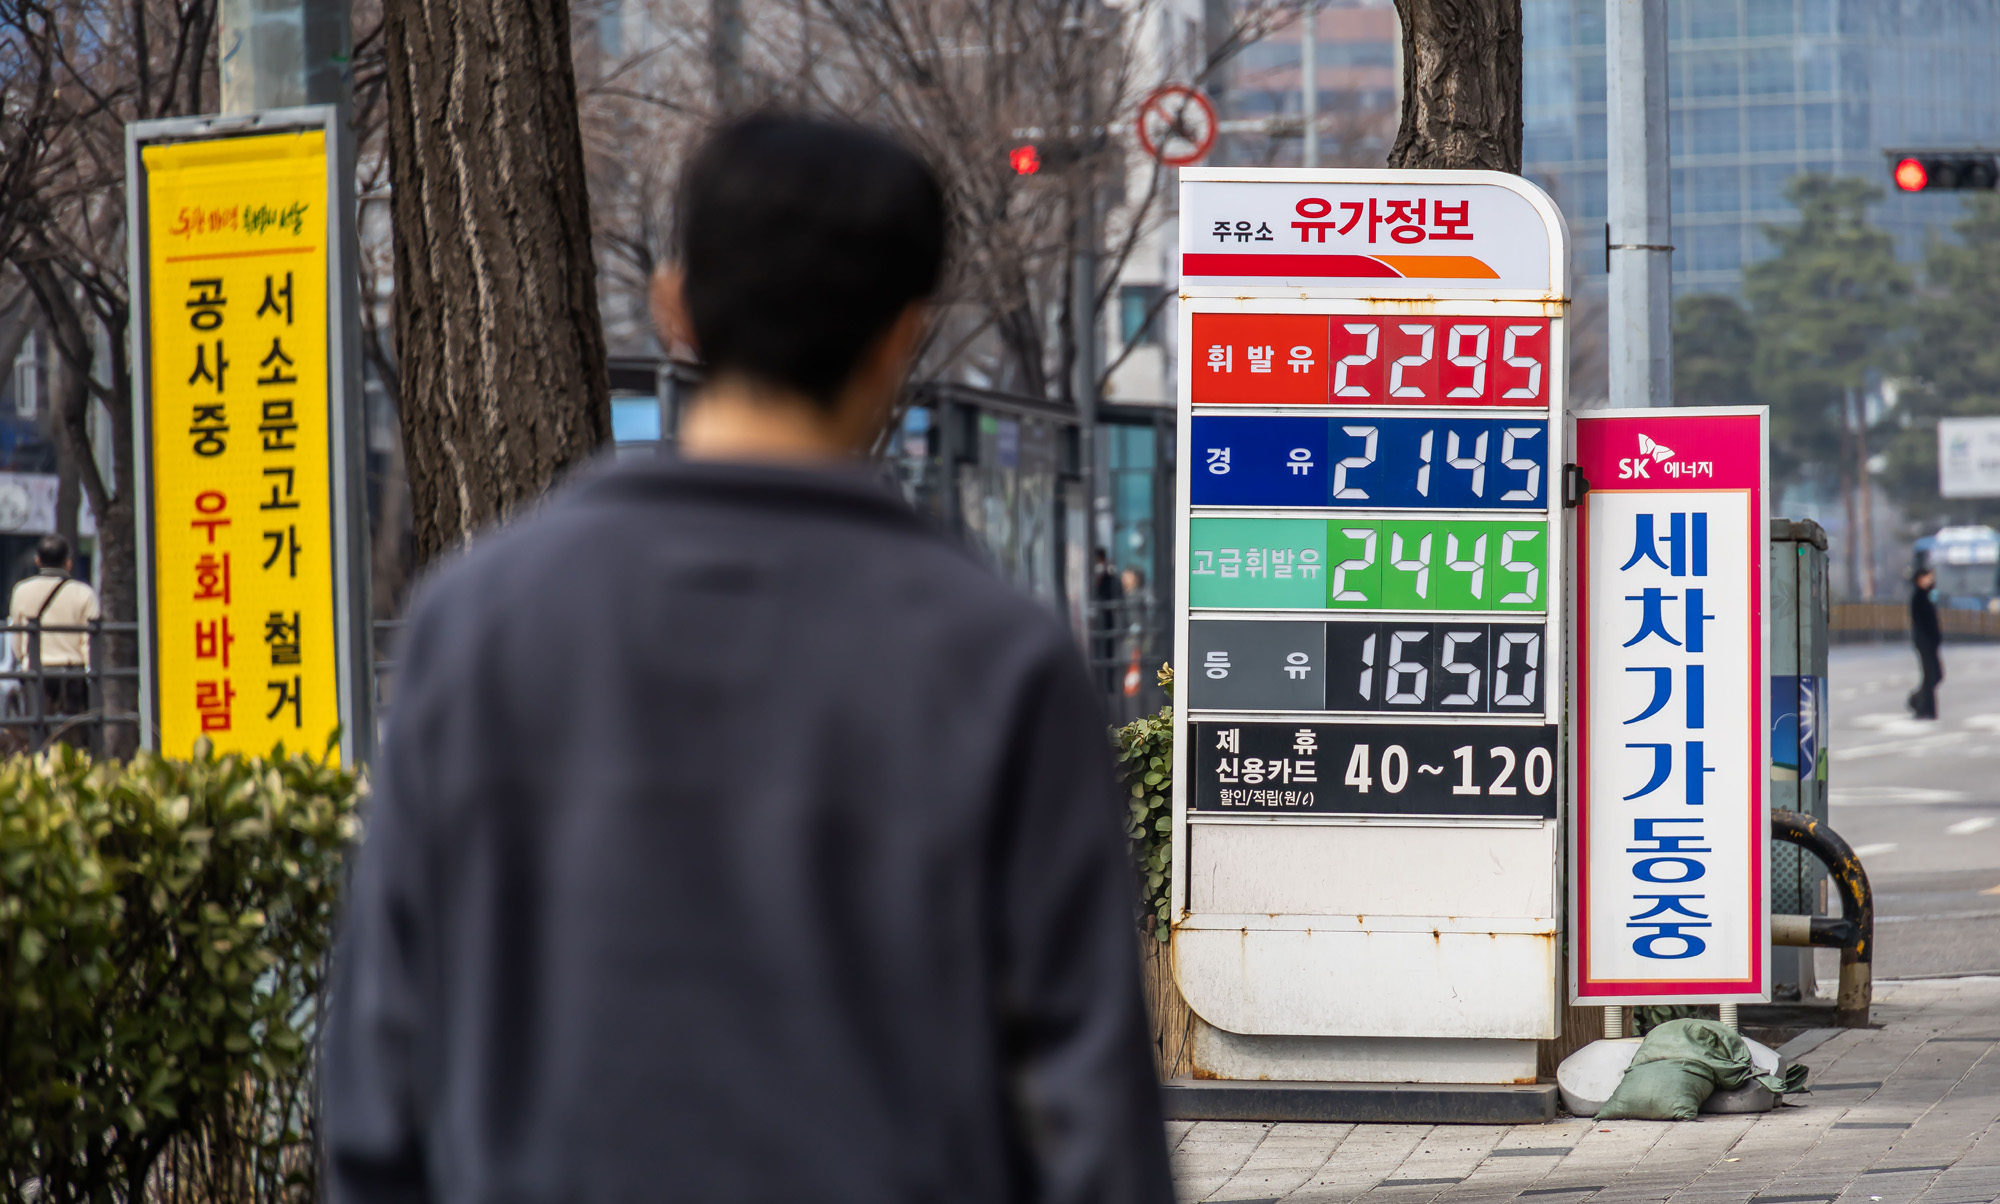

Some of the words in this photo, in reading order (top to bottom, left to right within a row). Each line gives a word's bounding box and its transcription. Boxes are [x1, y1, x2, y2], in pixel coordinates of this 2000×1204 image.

[1213, 221, 1273, 242] 주유소
[1291, 198, 1473, 244] 유가정보
[186, 278, 229, 457] 공사중
[1207, 345, 1315, 373] 휘발유
[1333, 323, 1542, 398] 2295
[256, 272, 301, 579] 서소문고가
[1332, 425, 1541, 501] 2145
[1618, 458, 1651, 479] SK
[1664, 461, 1713, 478] 에너지
[1191, 548, 1321, 579] 고급휘발유
[1332, 527, 1541, 603] 2445
[190, 491, 236, 732] 우회바람
[265, 611, 302, 728] 철거
[1358, 630, 1540, 706] 1650
[1216, 758, 1318, 784] 신용카드
